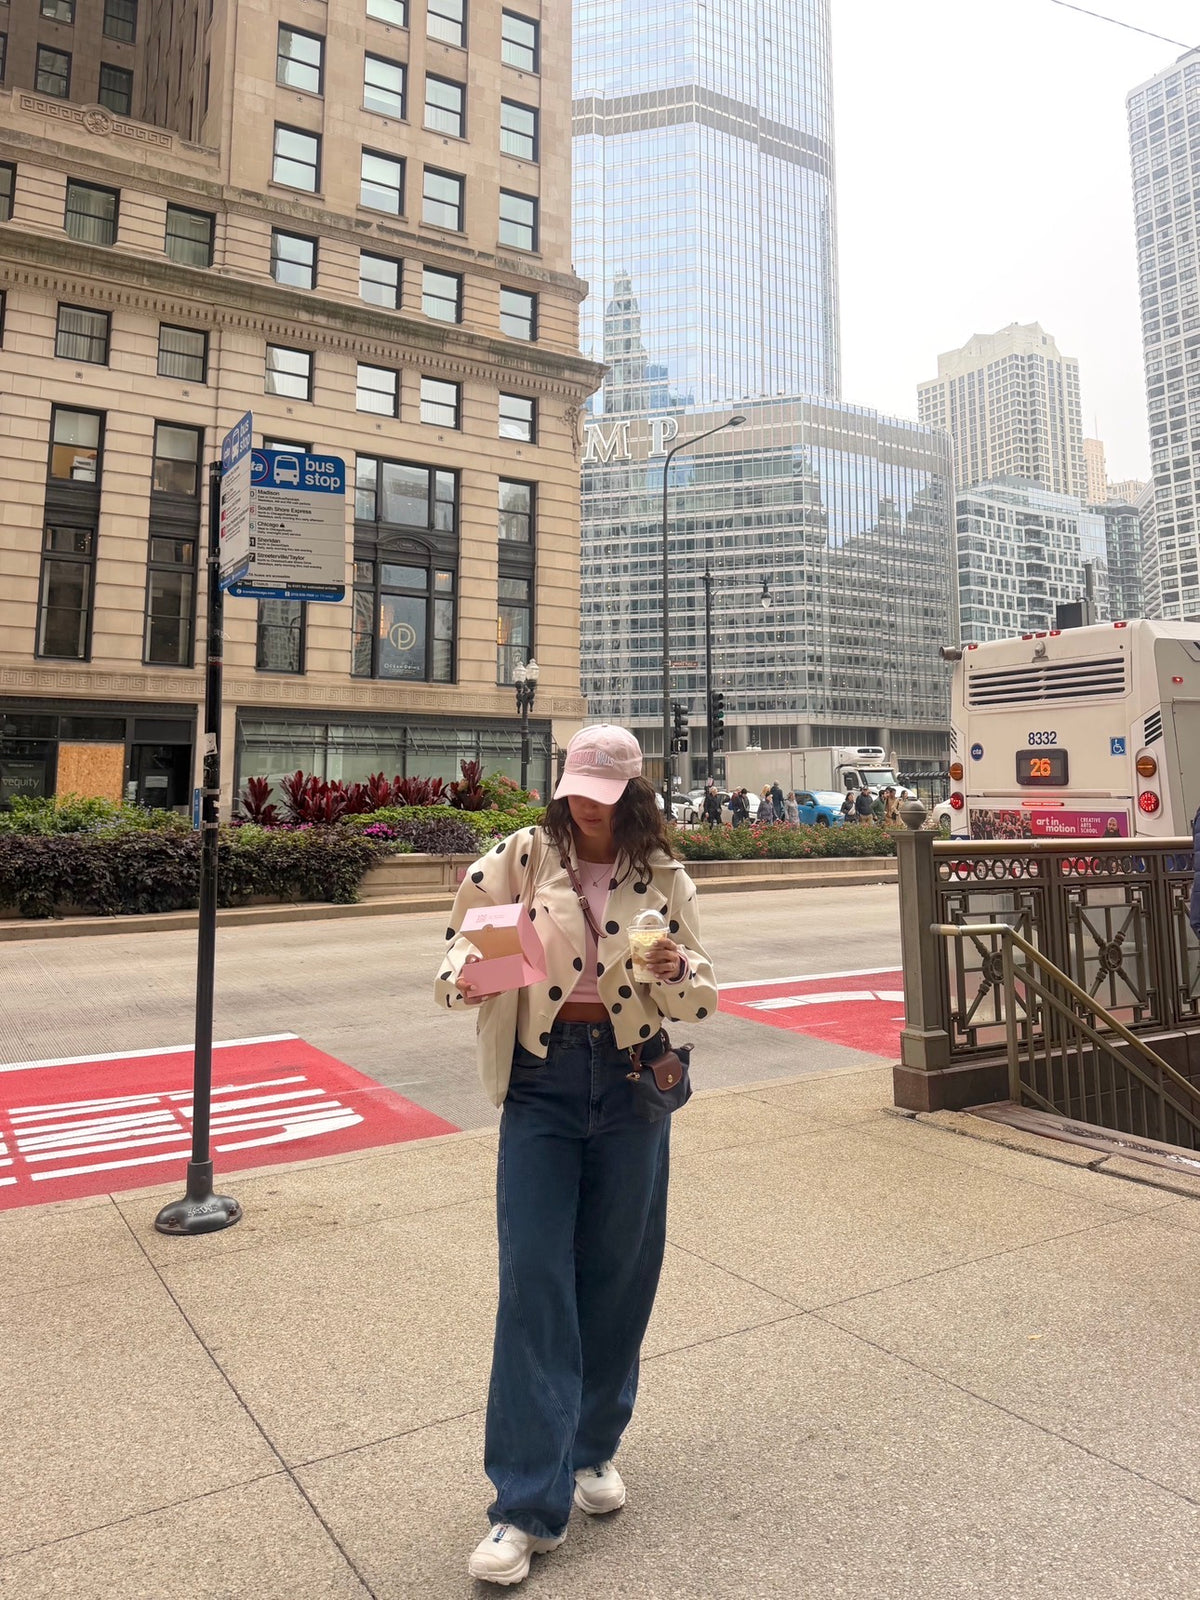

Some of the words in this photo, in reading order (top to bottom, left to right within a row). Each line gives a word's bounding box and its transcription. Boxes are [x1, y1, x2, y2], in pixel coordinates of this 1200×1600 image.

[251, 461, 263, 472] ta
[305, 457, 334, 474] bus
[305, 473, 340, 490] stop
[257, 504, 273, 512] South
[1028, 731, 1057, 746] 8332
[1029, 758, 1051, 778] 26
[1036, 816, 1049, 826] art
[1050, 816, 1060, 826] in
[1045, 823, 1076, 834] motion
